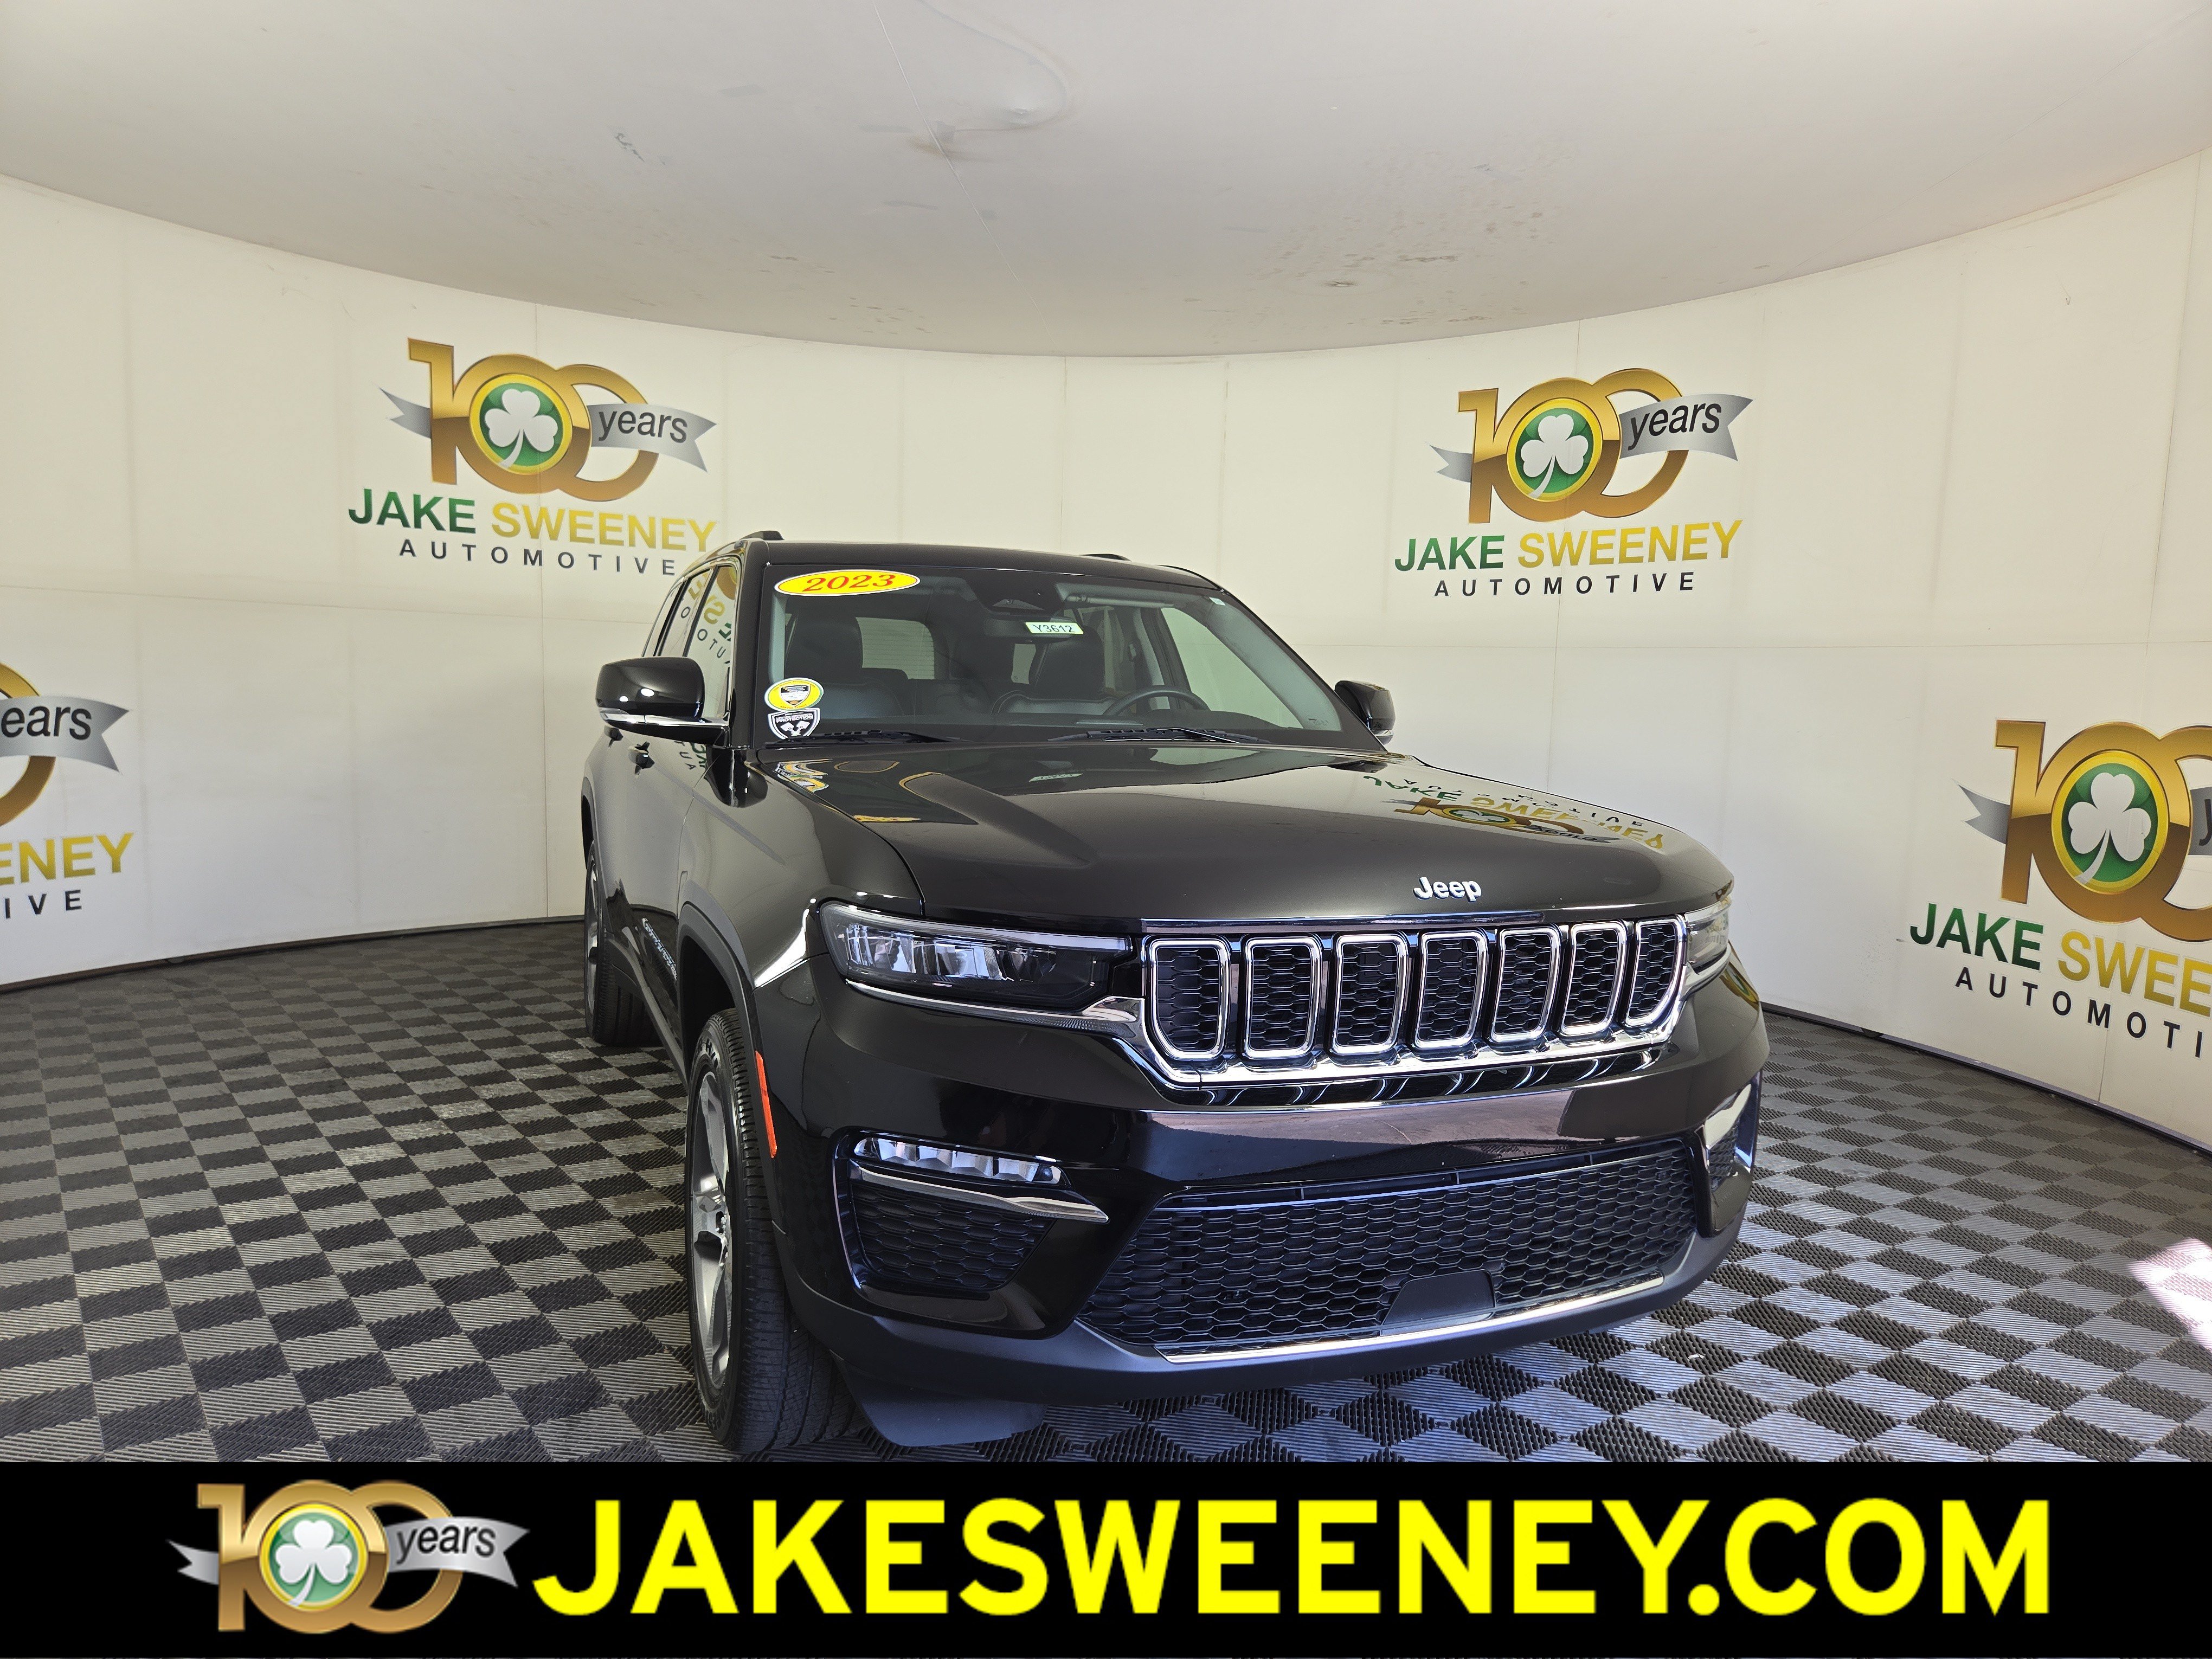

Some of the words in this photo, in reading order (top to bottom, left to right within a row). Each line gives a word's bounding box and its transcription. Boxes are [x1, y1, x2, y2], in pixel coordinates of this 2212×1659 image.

[597, 409, 689, 443] years
[1628, 402, 1722, 451] years
[348, 488, 476, 534] JAKE
[492, 501, 717, 552] SWEENEY
[399, 539, 676, 576] AUTOMOTIVE
[1394, 535, 1505, 572] JAKE
[1518, 519, 1742, 568] SWEENEY
[802, 575, 896, 592] 2023
[1434, 572, 1694, 597] AUTOMOTIVE
[1033, 625, 1075, 633] Y3612
[1413, 877, 1482, 902] Jeep
[1909, 903, 2044, 971] JAKE
